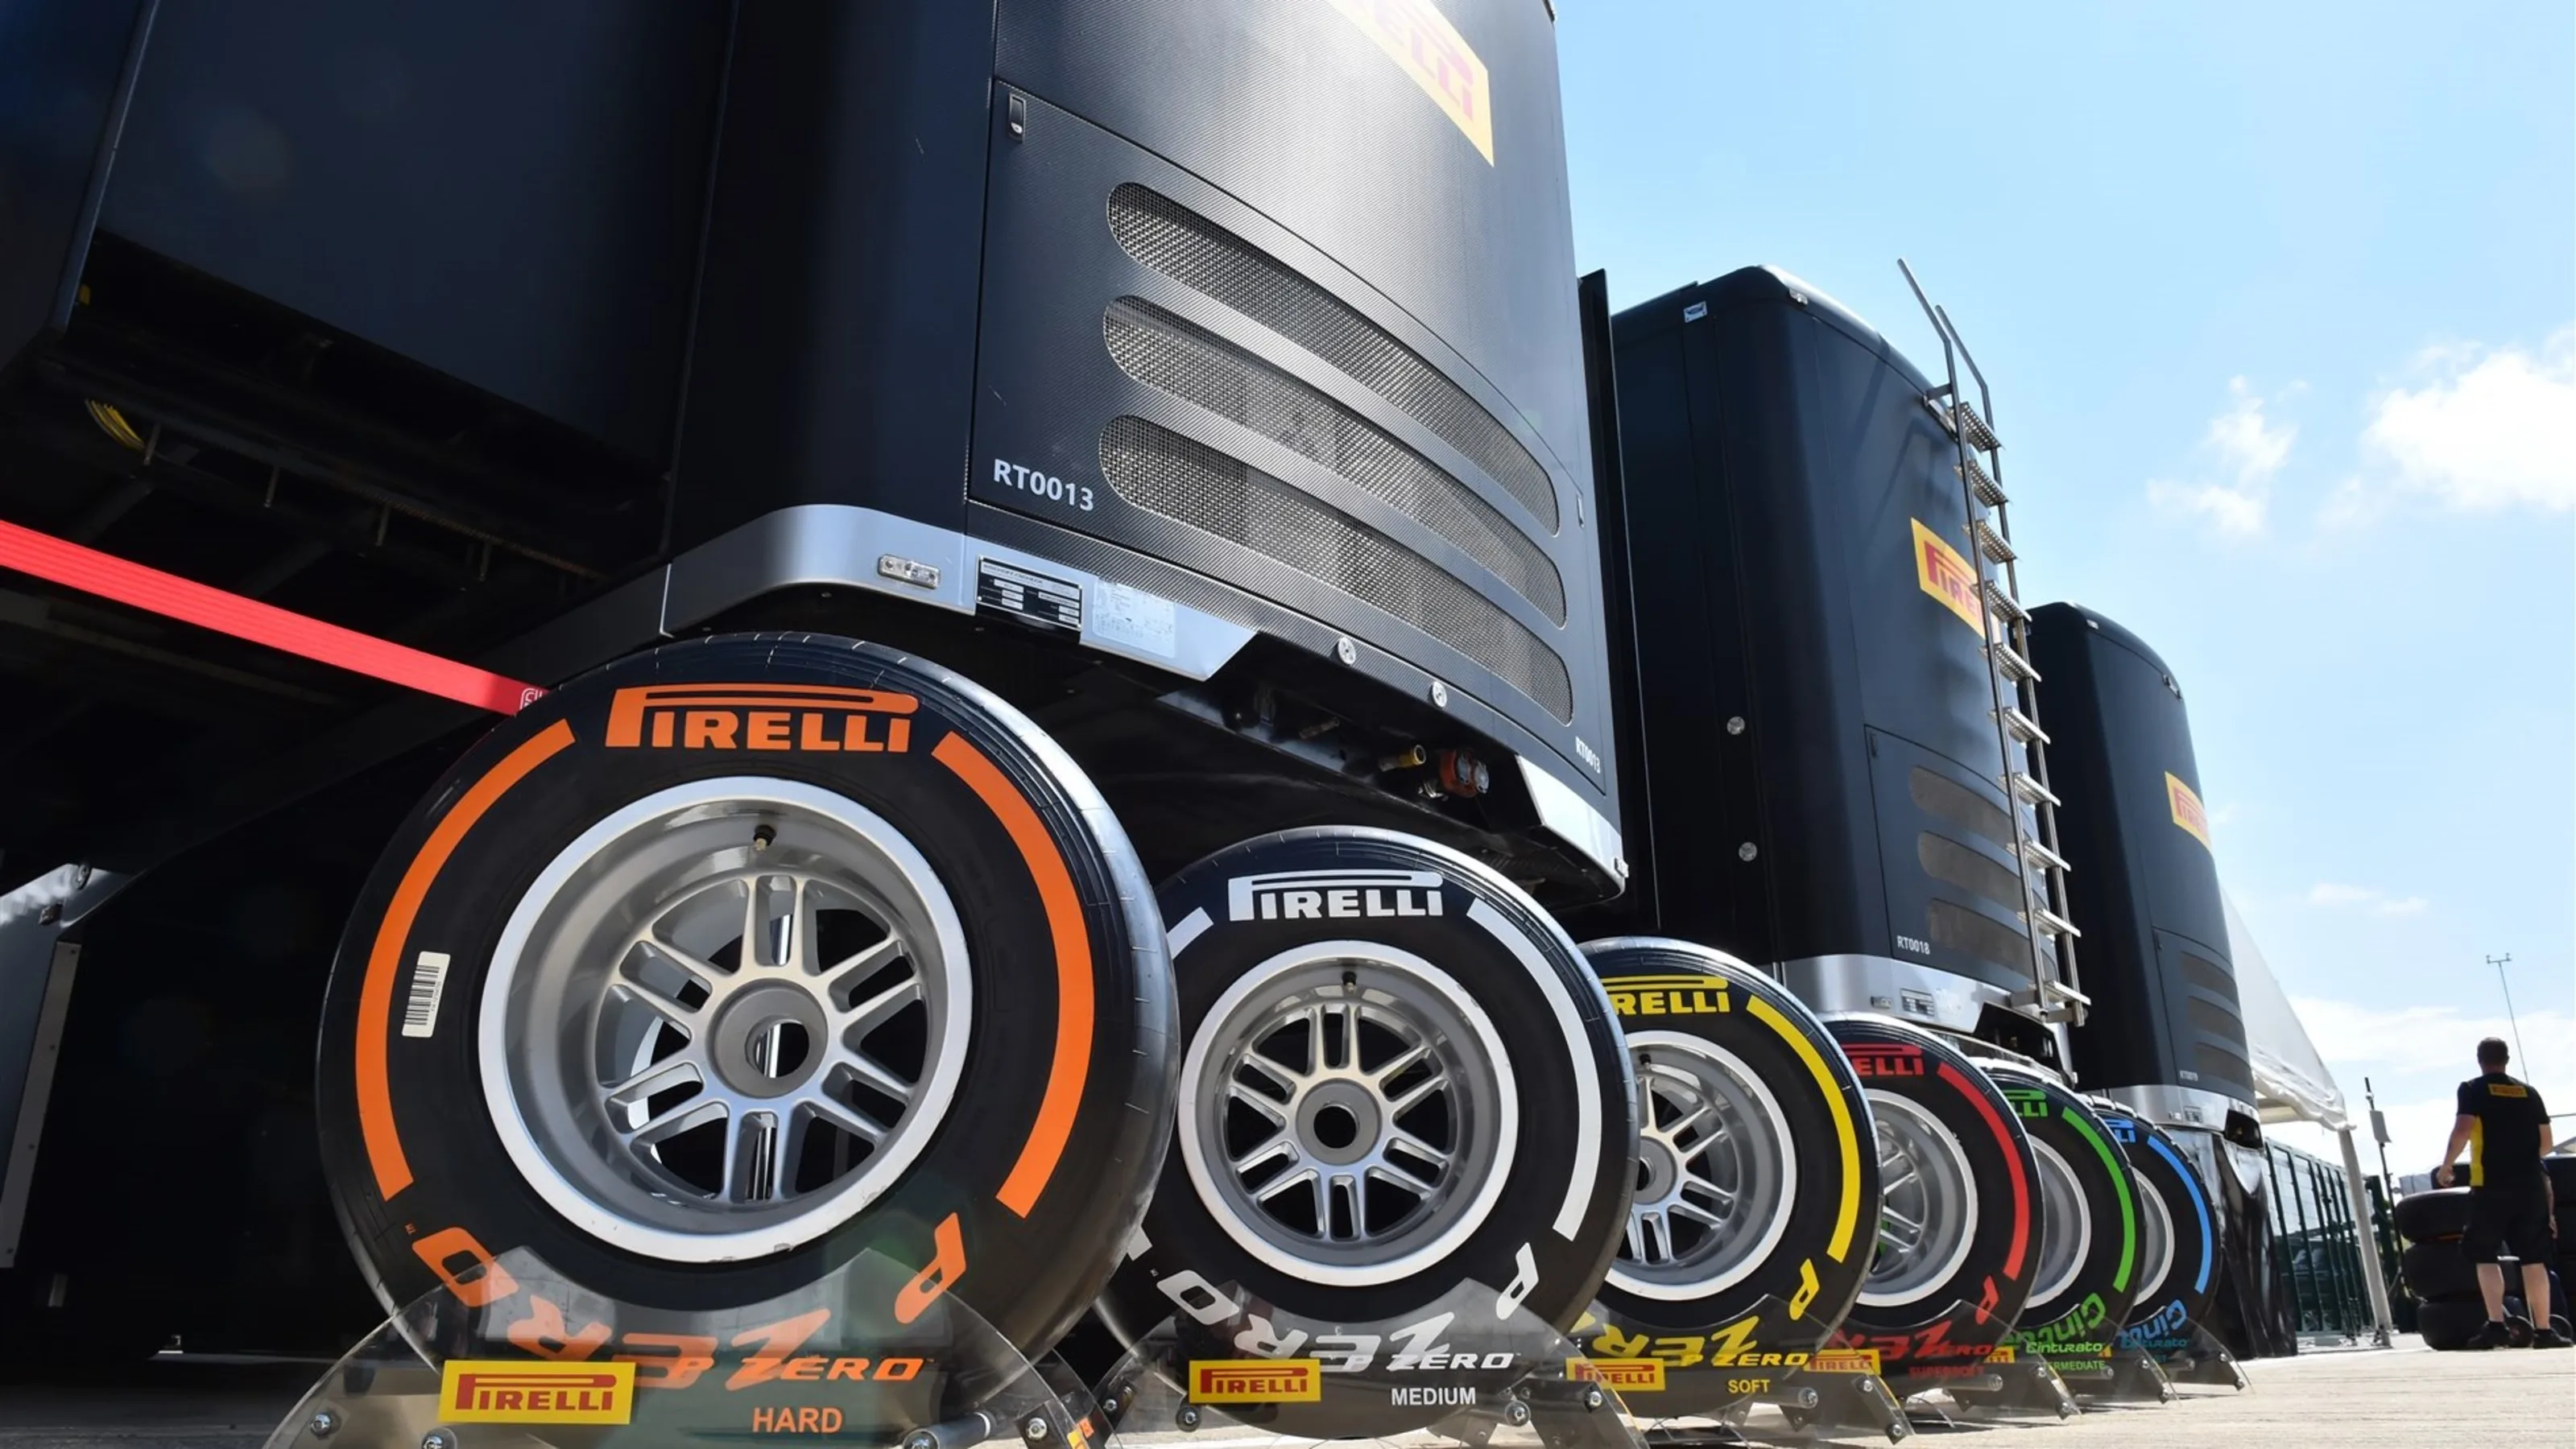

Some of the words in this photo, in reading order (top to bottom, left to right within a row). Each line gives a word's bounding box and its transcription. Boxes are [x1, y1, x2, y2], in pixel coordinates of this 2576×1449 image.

[1354, 0, 1474, 122] ELLI
[994, 458, 1094, 512] RT0013
[1924, 540, 1984, 624] PIRE
[605, 683, 919, 753] PIRELLI
[1575, 736, 1601, 774] RT0013
[1228, 870, 1443, 921] PIRELLI
[1896, 935, 1931, 956] RT0018
[1599, 974, 1730, 1015] RELLI
[1842, 1043, 1925, 1075] ELLI
[735, 1356, 924, 1381] ZERO
[1386, 1352, 1515, 1369] ZERO
[1713, 1352, 1809, 1367] ZERO
[456, 1373, 617, 1410] PIRELLI
[1200, 1368, 1309, 1393] PIRELLI
[1391, 1387, 1476, 1406] MEDIUM
[1727, 1380, 1771, 1393] SOFT
[752, 1407, 843, 1433] HARD
